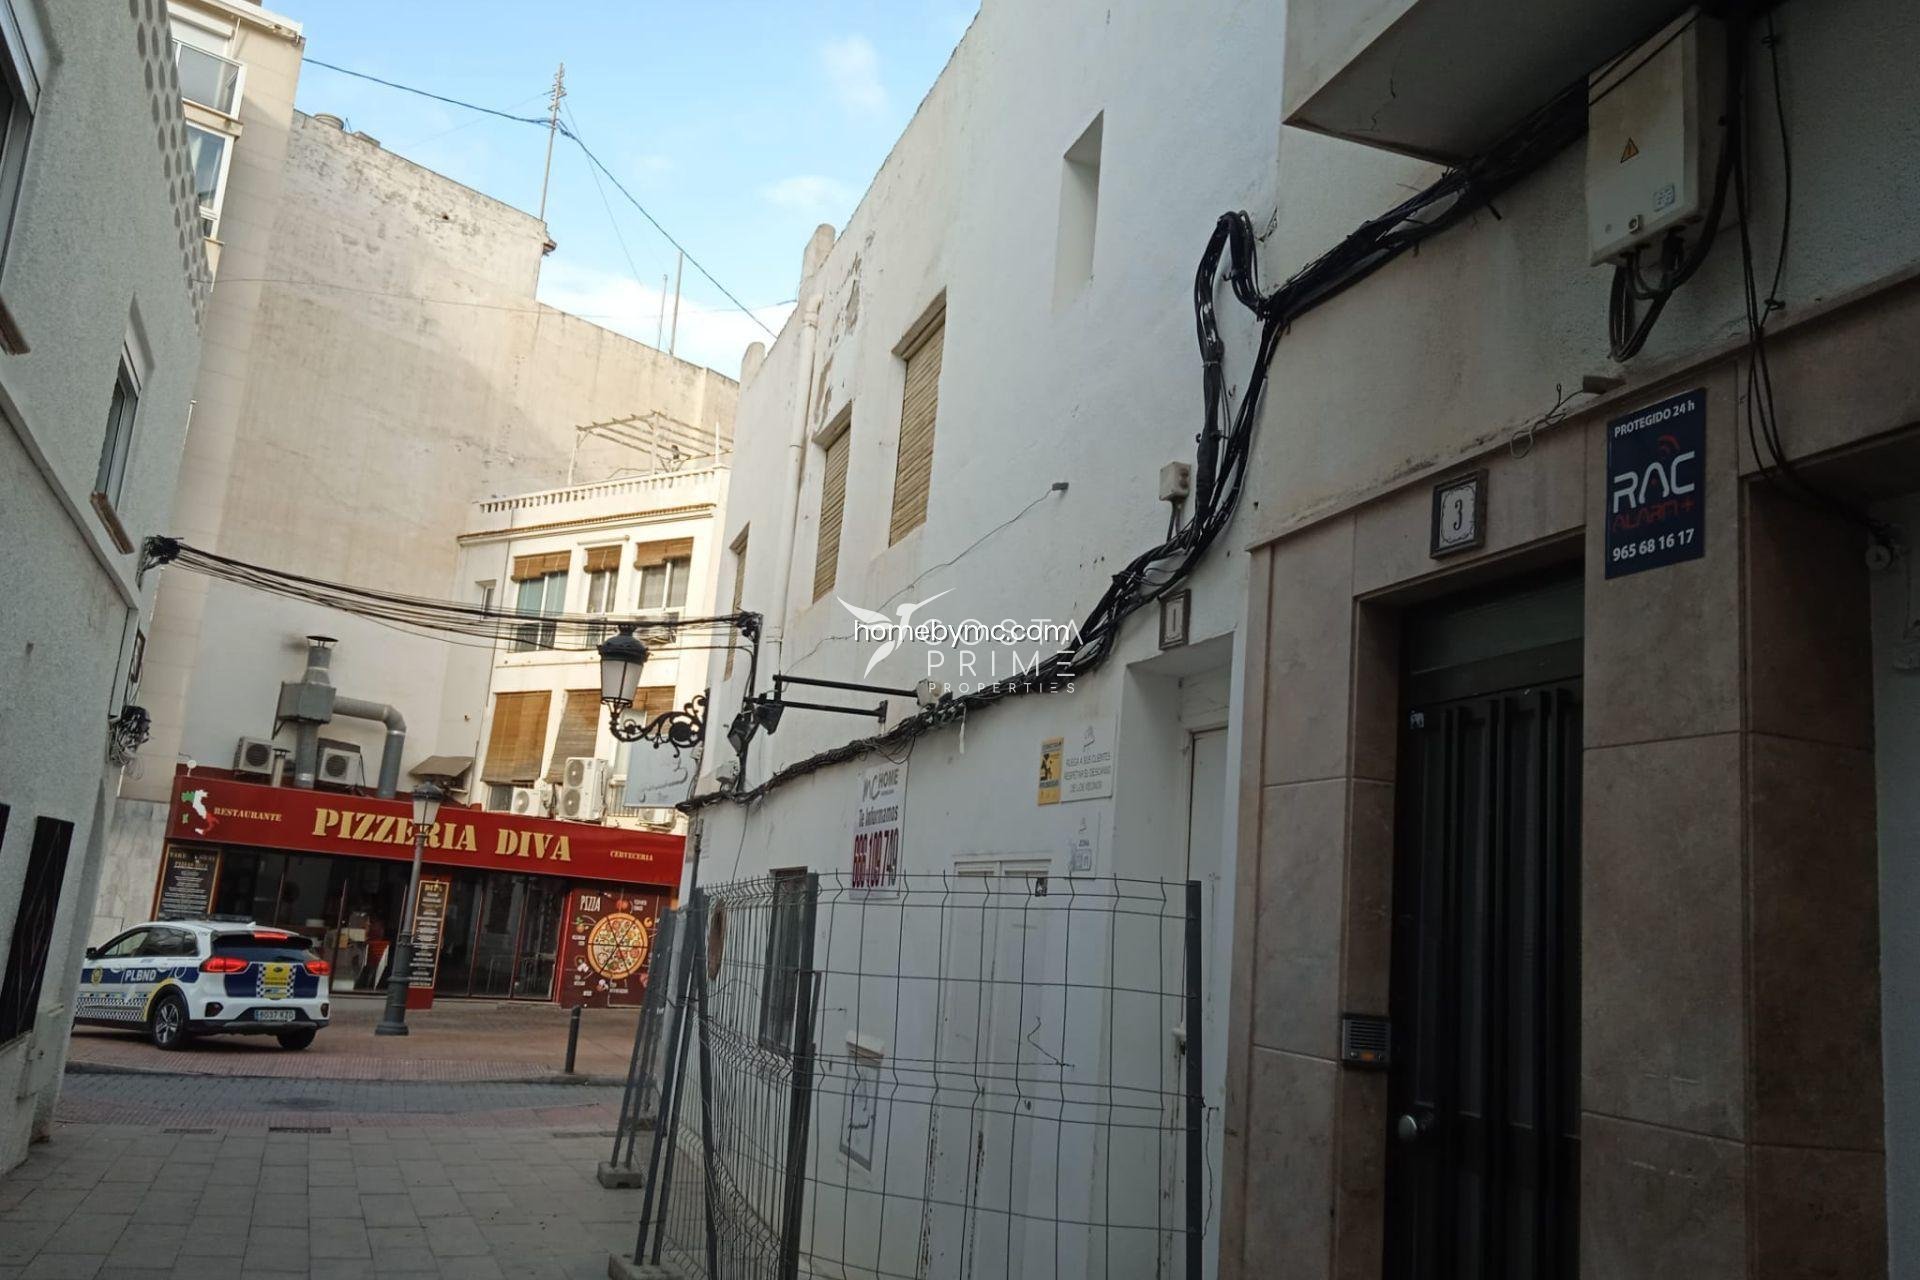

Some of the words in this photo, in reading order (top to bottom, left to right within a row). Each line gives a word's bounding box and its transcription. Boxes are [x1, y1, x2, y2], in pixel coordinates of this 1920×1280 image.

[1614, 408, 1671, 438] PROTEGIDO
[1672, 403, 1686, 417] 24
[1612, 451, 1696, 514] RAC
[1453, 498, 1463, 531] 3
[1612, 543, 1637, 562] 965
[1638, 538, 1656, 555] 68
[1658, 533, 1675, 550] 16
[1678, 527, 1695, 546] 17
[879, 769, 899, 788] HOME
[213, 806, 282, 822] RESTAURANTE
[312, 807, 477, 852] PIZZERIA
[495, 828, 571, 862] DIVA
[609, 850, 654, 862] CERVECERIA
[580, 895, 601, 912] PIZZA
[124, 969, 157, 981] PLBND
